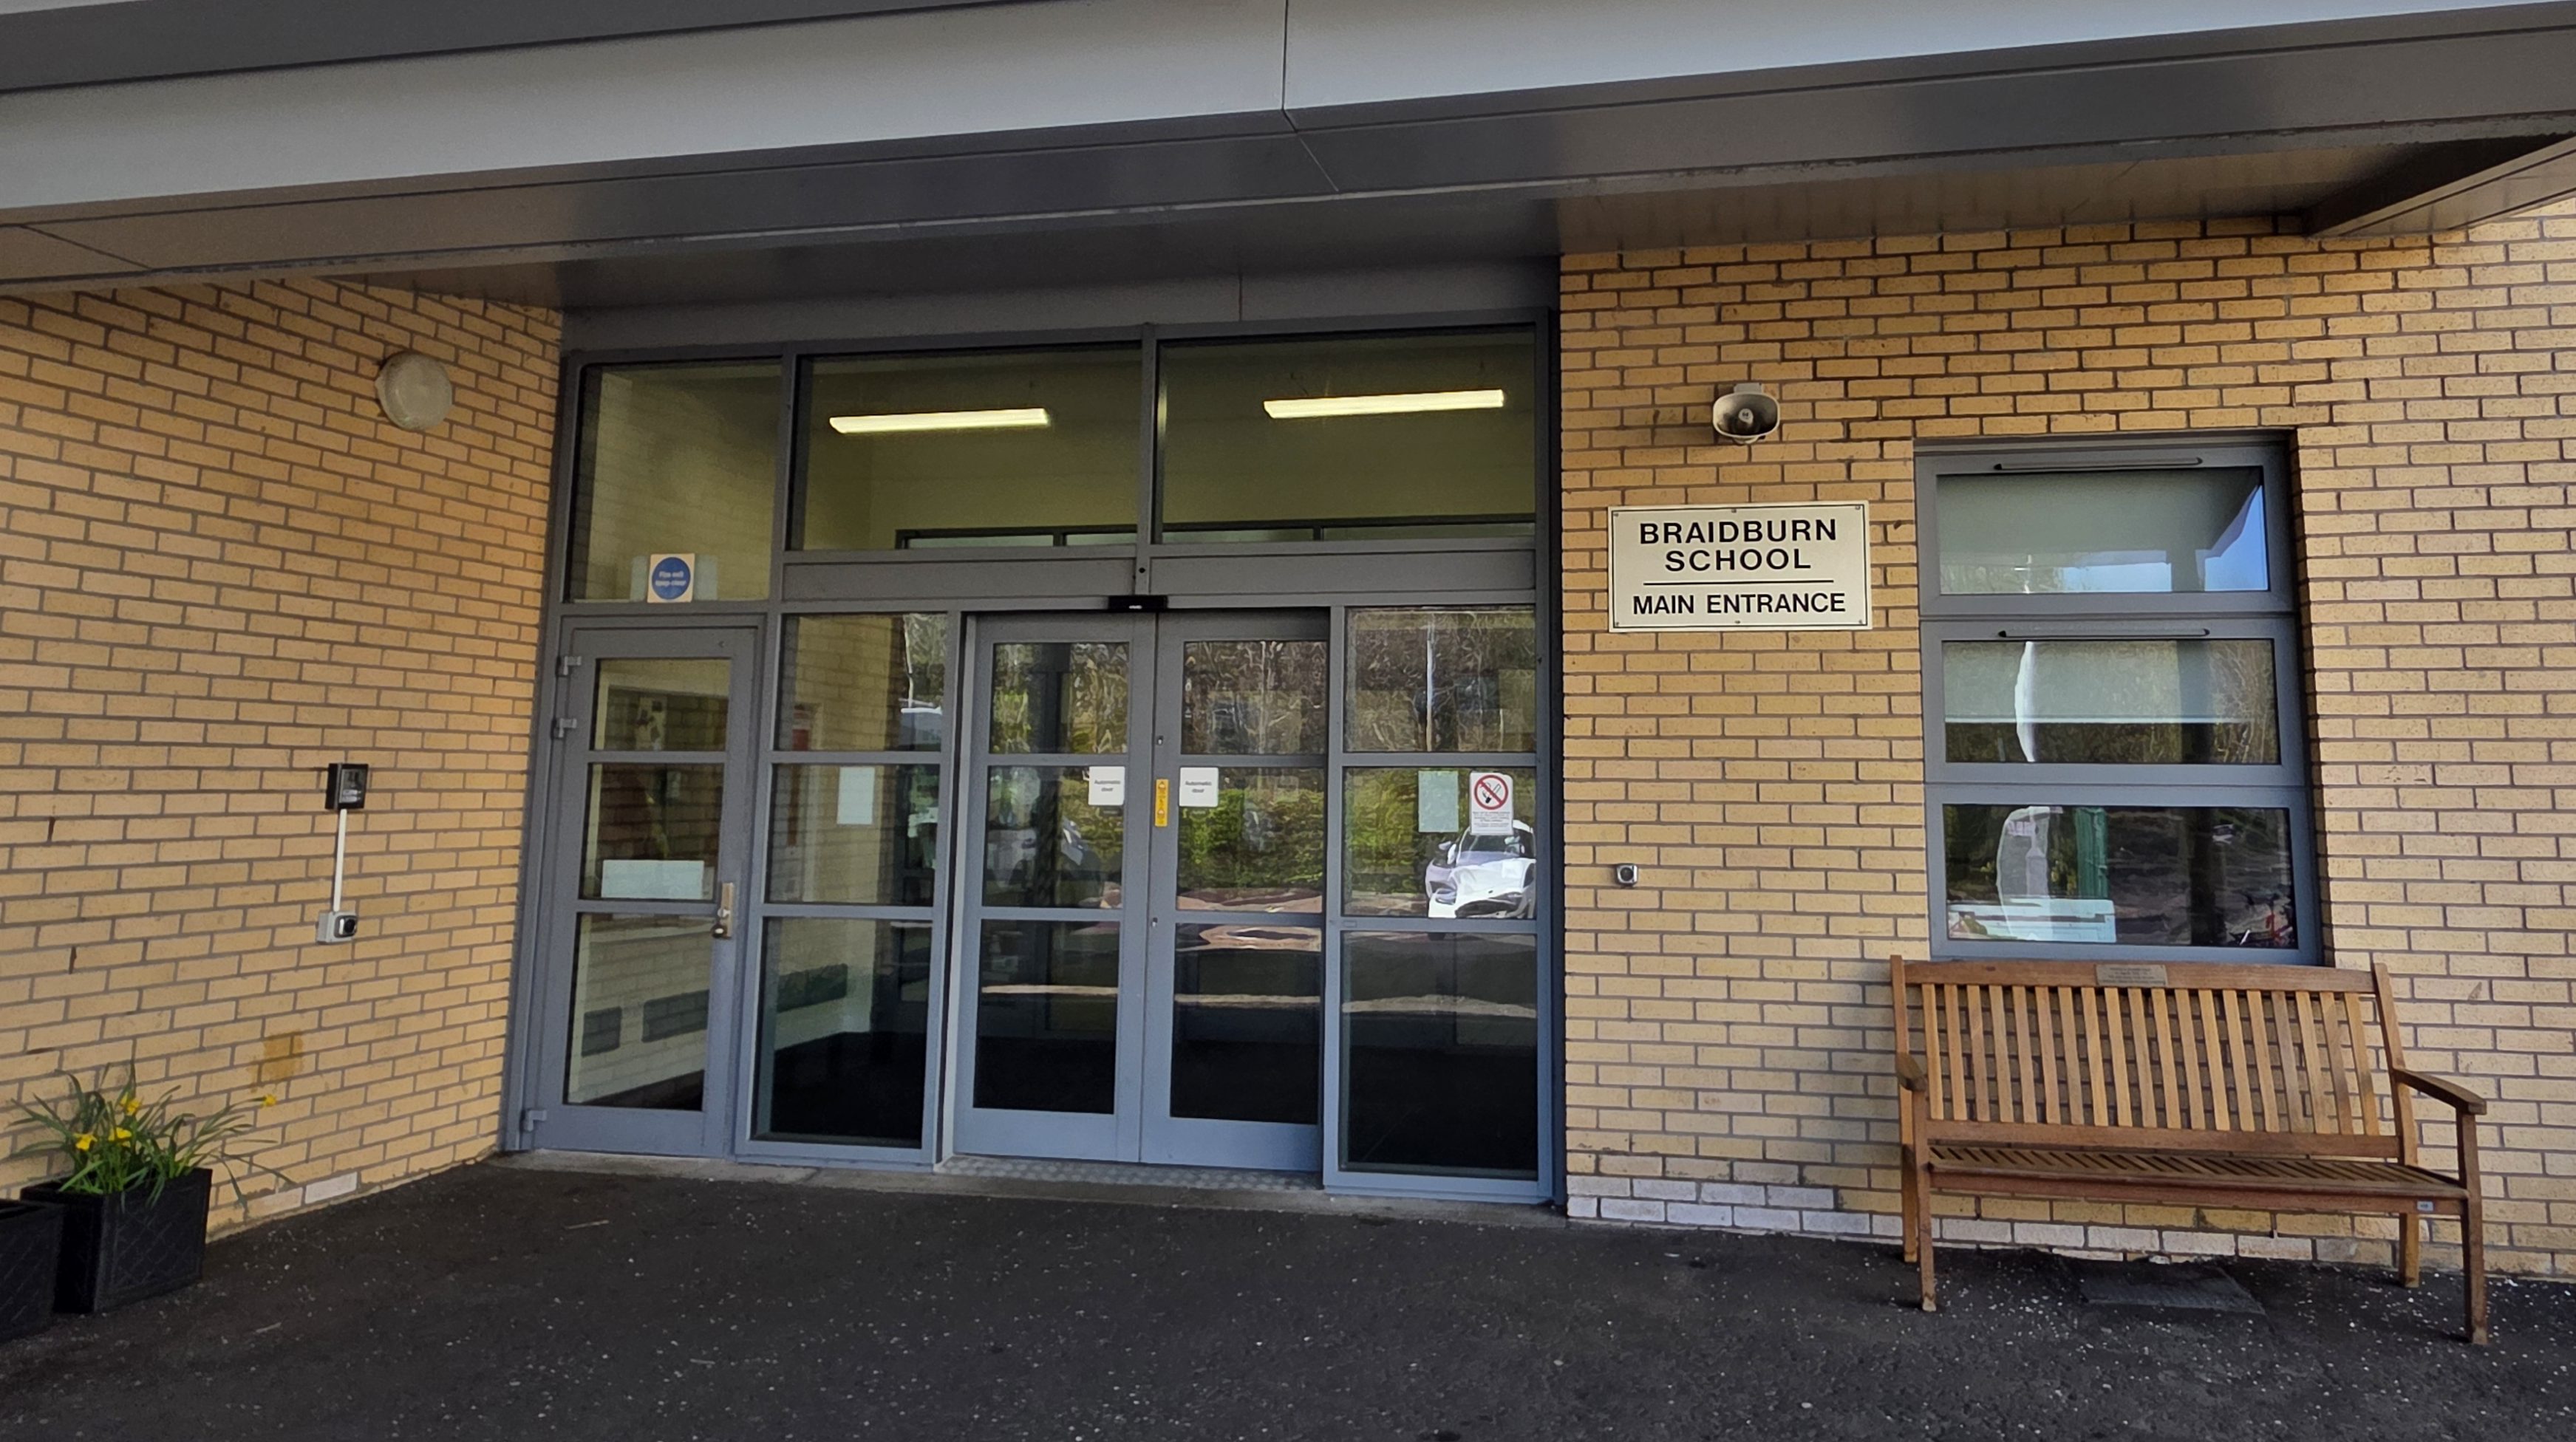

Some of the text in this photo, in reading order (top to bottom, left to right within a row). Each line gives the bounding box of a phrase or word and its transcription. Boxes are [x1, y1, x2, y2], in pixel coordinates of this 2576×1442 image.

[1640, 519, 1836, 544] BRAIDBURN
[1665, 548, 1811, 572] SCHOOL
[1633, 593, 1846, 615] MAIN ENTRANCE
